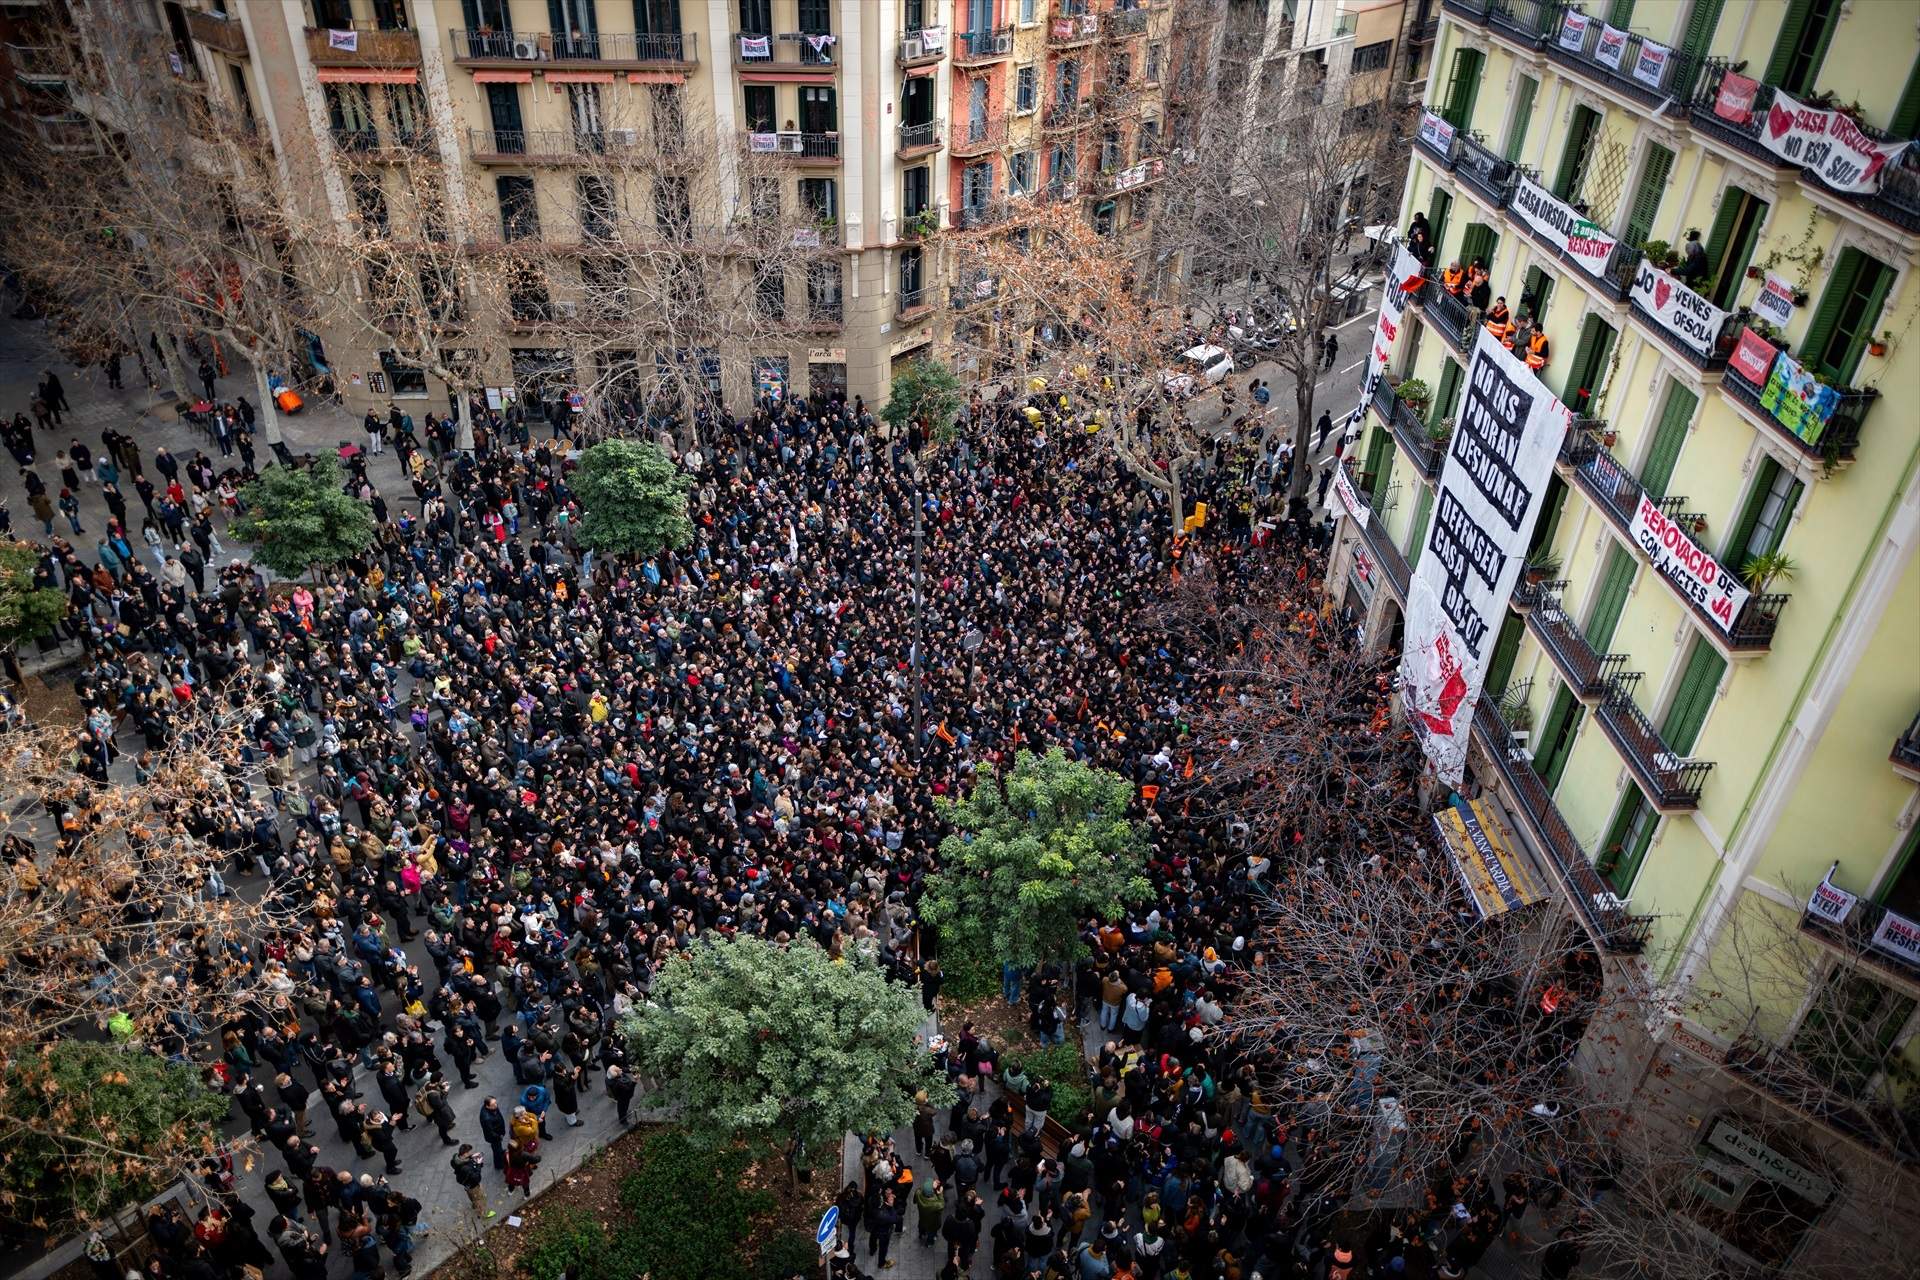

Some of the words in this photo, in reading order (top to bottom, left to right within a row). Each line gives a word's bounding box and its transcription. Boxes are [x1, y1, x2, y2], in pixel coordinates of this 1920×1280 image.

[1794, 109, 1829, 136] CASA
[1784, 135, 1801, 158] NO
[1825, 155, 1861, 186] SOLA
[1518, 185, 1541, 218] CASA
[1539, 200, 1574, 237] ORSOLA
[1573, 222, 1579, 234] 2
[1579, 226, 1599, 240] anys
[1634, 267, 1654, 294] JO
[1474, 358, 1495, 397] NO
[1492, 378, 1520, 425] ENS
[1465, 393, 1520, 468] PODRAN
[1456, 428, 1527, 522] DESNONAR
[1435, 525, 1465, 582] CASA
[1716, 572, 1737, 599] DE
[1711, 596, 1735, 626] JA
[1465, 818, 1477, 834] LA
[1471, 831, 1511, 893] VANGUARDIA
[1890, 920, 1913, 937] CASA
